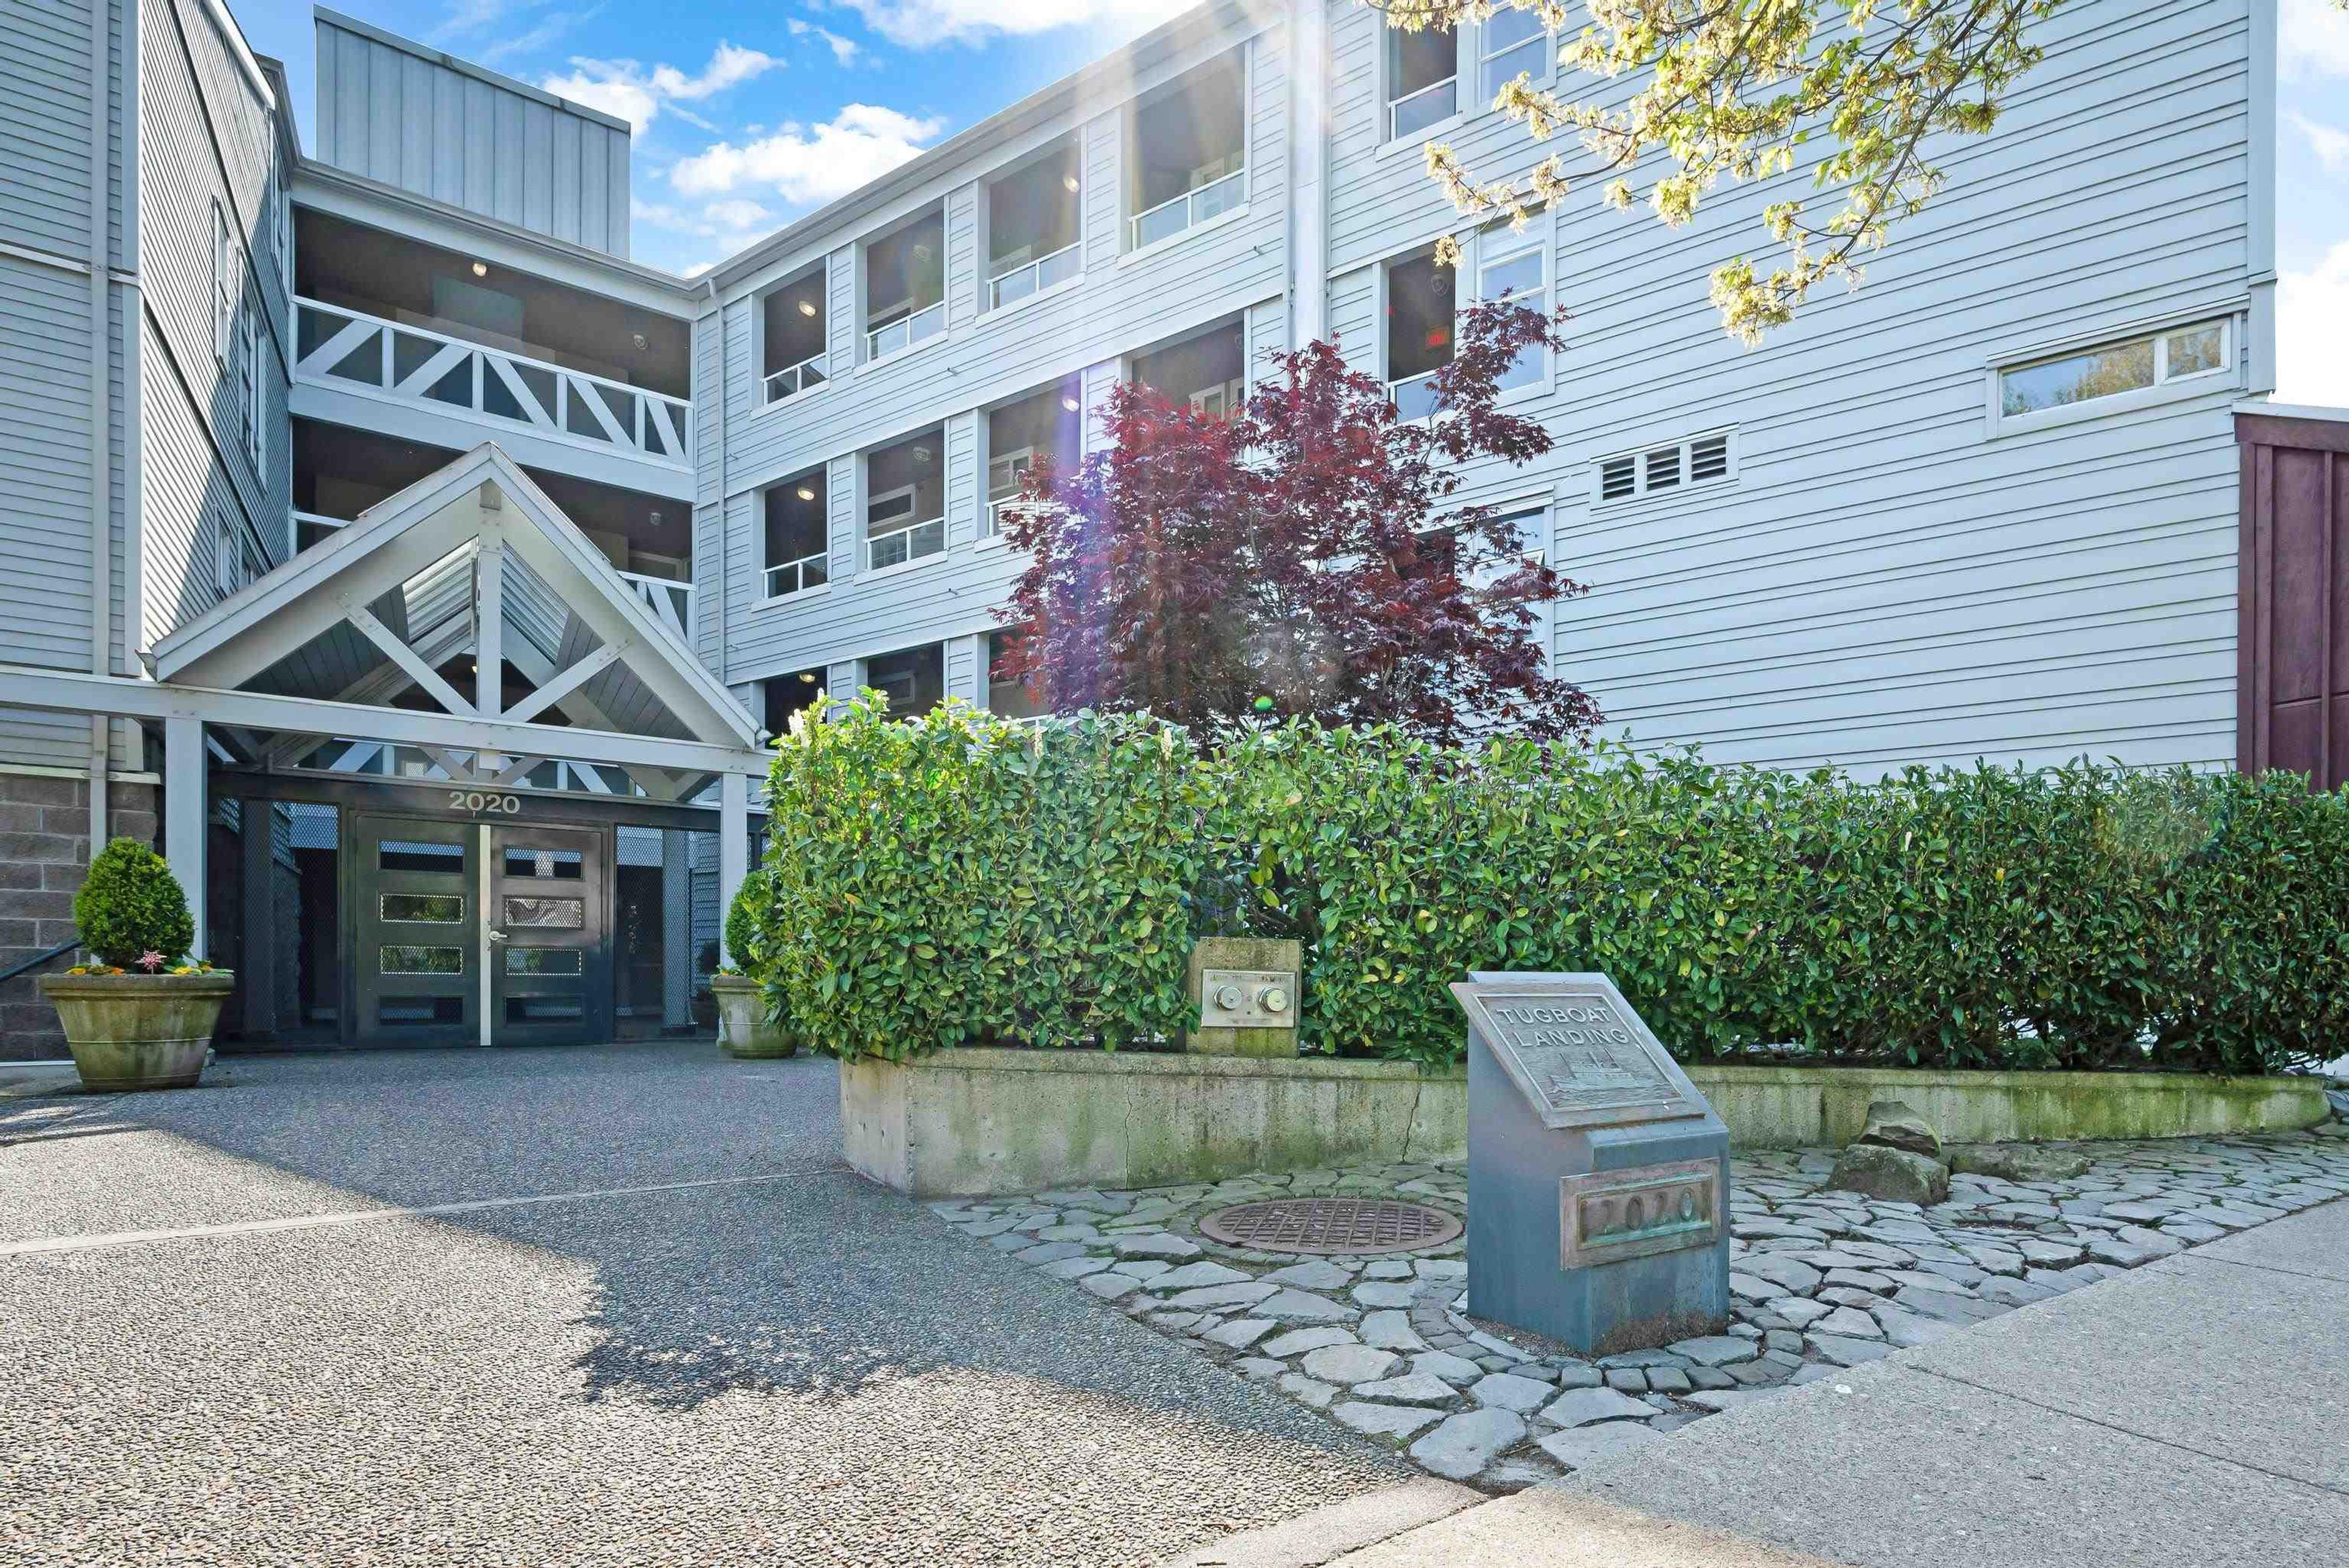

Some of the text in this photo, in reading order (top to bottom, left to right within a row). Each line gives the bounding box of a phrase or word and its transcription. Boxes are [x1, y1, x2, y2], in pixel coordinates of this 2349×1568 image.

[449, 791, 520, 814] 2020
[1496, 1007, 1611, 1024] TUGBOAT
[1513, 1029, 1629, 1047] LANDING
